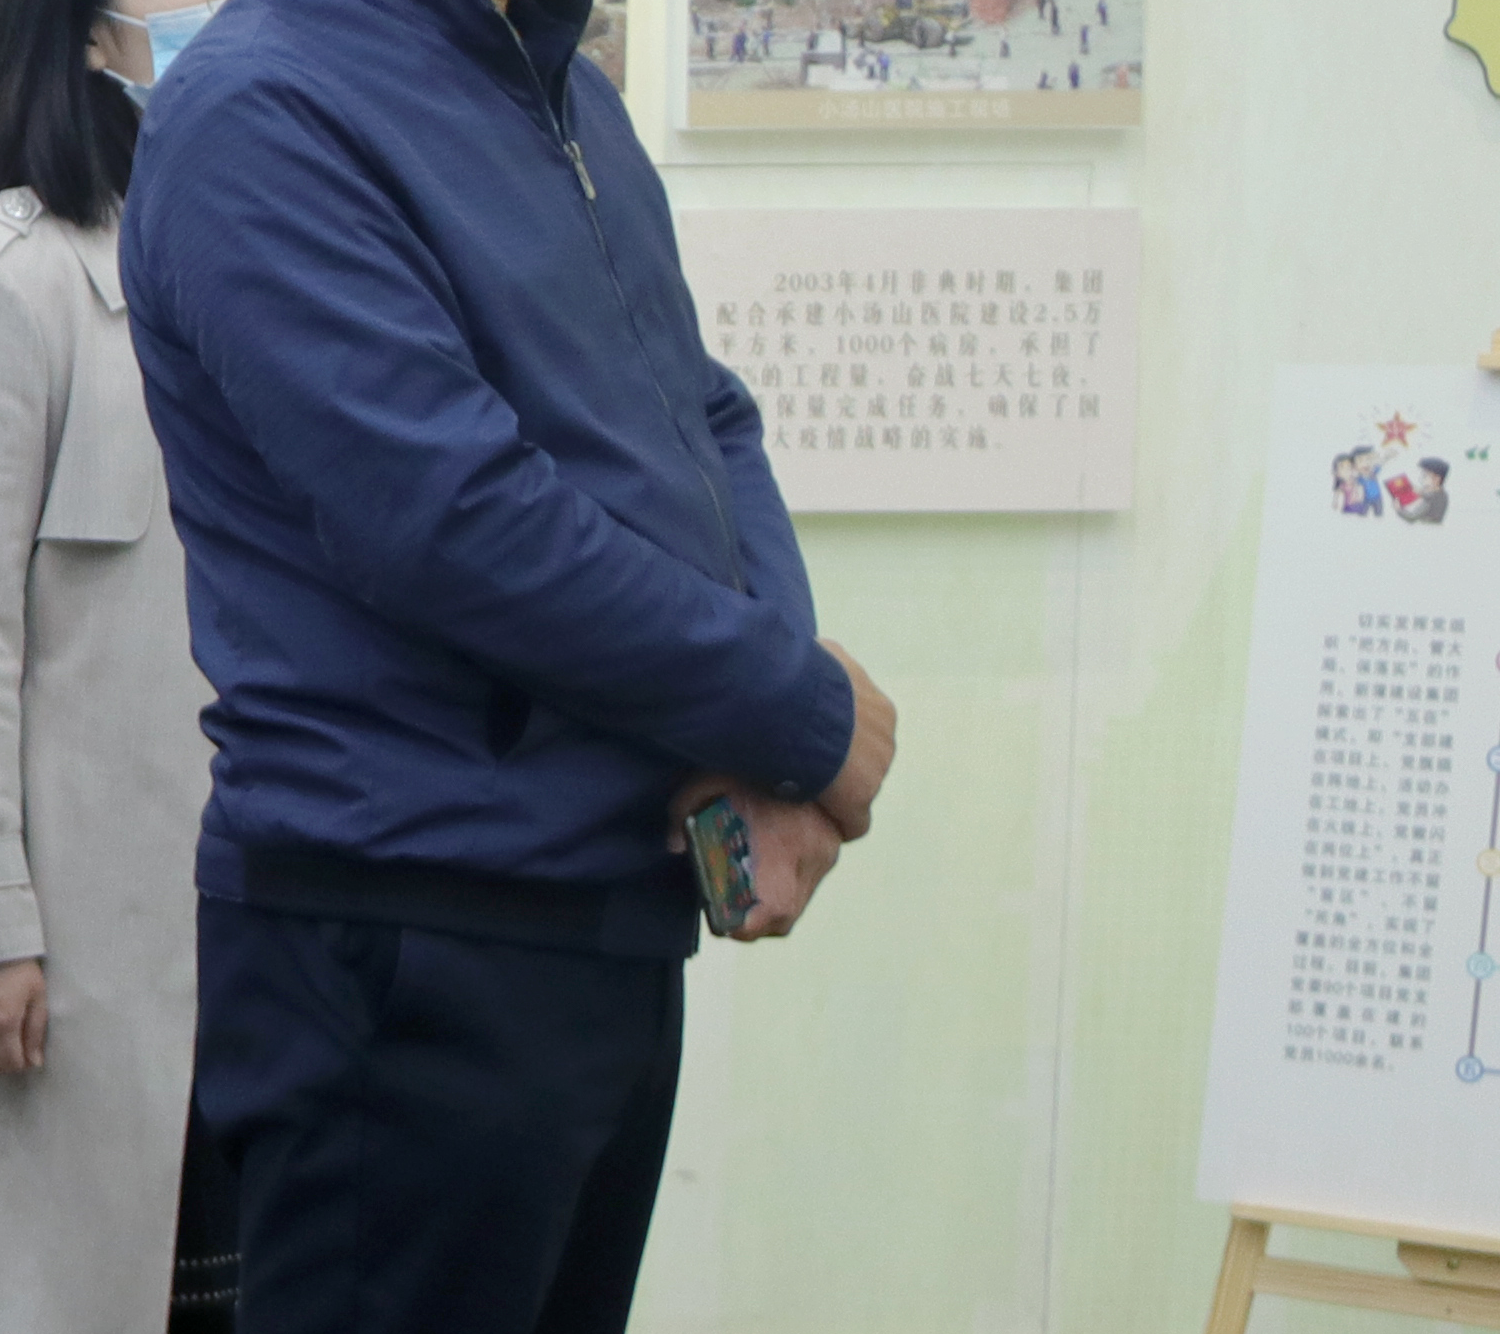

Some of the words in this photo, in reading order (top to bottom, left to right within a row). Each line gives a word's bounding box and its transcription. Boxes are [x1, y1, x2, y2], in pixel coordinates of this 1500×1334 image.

[764, 394, 1101, 420] 保量完成任务，确保了国
